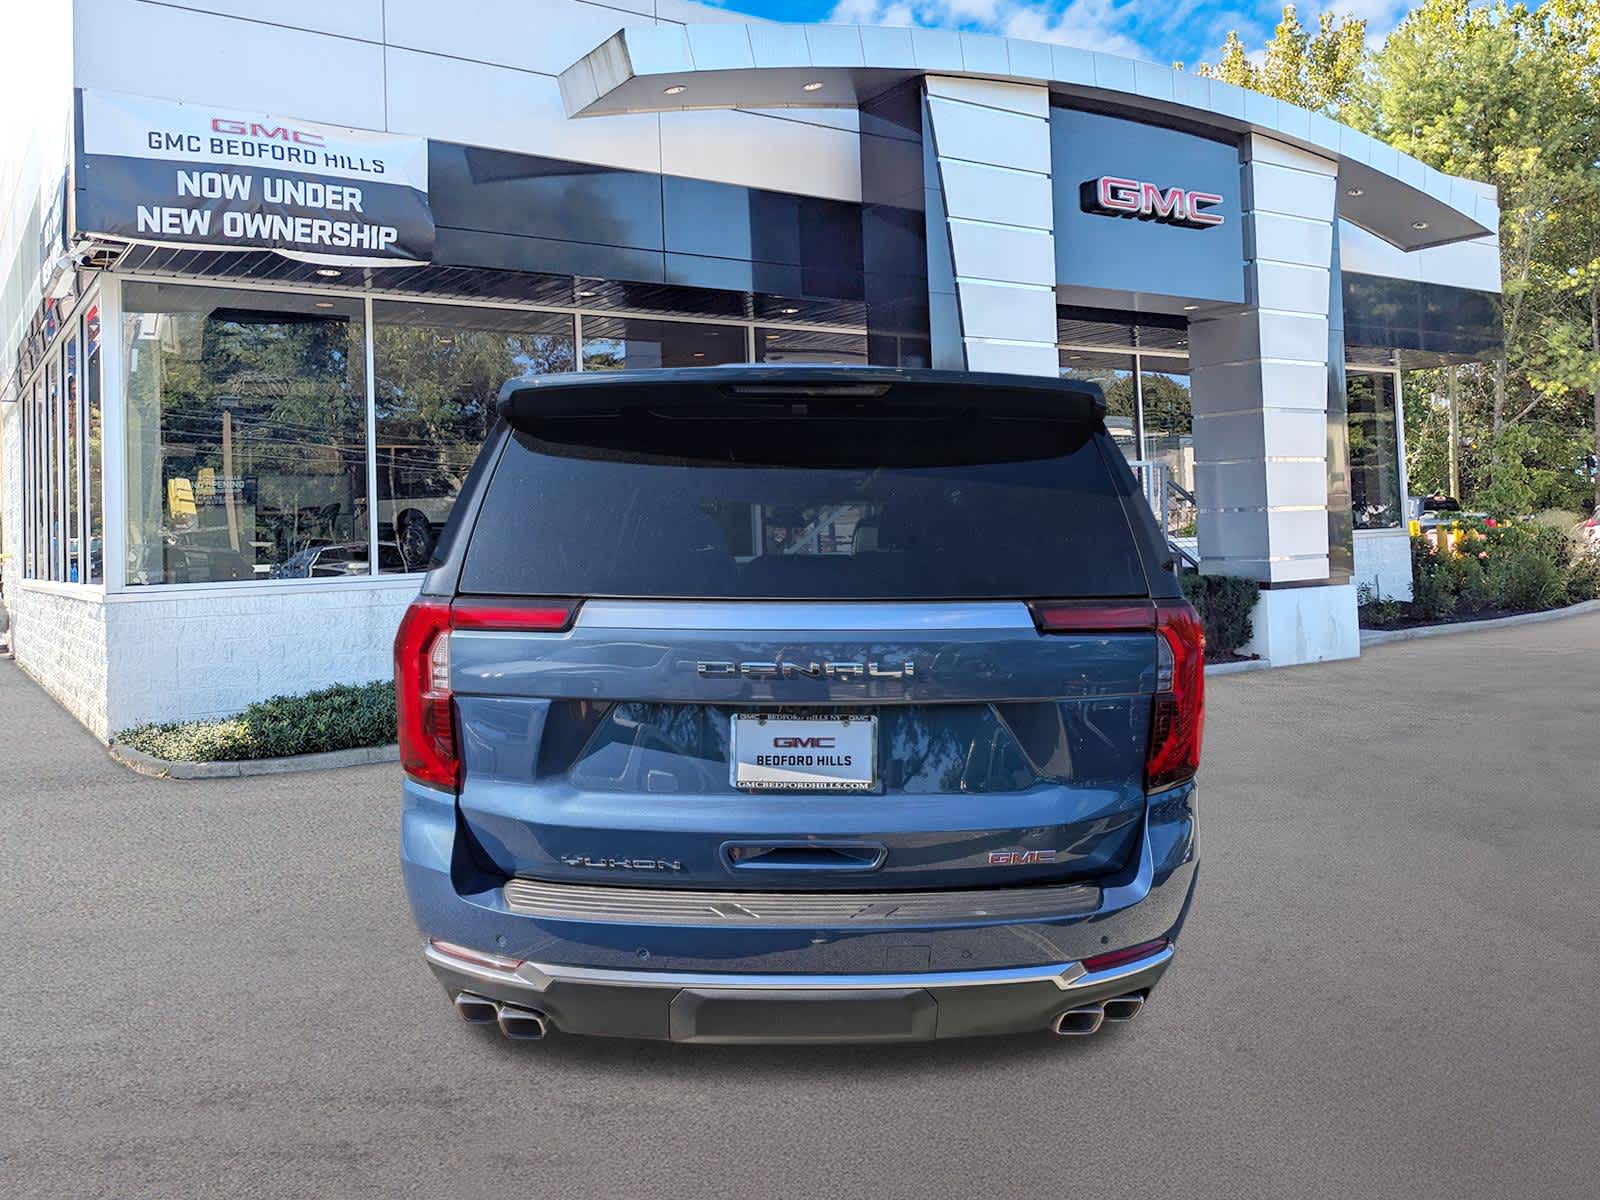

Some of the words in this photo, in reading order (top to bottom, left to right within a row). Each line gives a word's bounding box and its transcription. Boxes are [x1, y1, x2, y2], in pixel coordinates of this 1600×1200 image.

[211, 118, 325, 148] GMC
[147, 131, 201, 152] GMC
[209, 139, 317, 166] BEDFORD
[324, 154, 385, 174] HILLS
[176, 170, 252, 201] NOW
[263, 177, 363, 213] UNDER
[1097, 175, 1225, 225] GMC
[136, 206, 212, 236] NEW
[223, 211, 398, 250] OWNERSHIP
[697, 661, 915, 678] DENALI
[773, 737, 835, 748] GMC
[756, 755, 813, 766] BEDFORD
[816, 755, 852, 766] HILLS
[737, 781, 869, 789] GMCBEDFORDHILLS.COM
[560, 855, 681, 870] YUKON
[988, 850, 1057, 864] GMC
